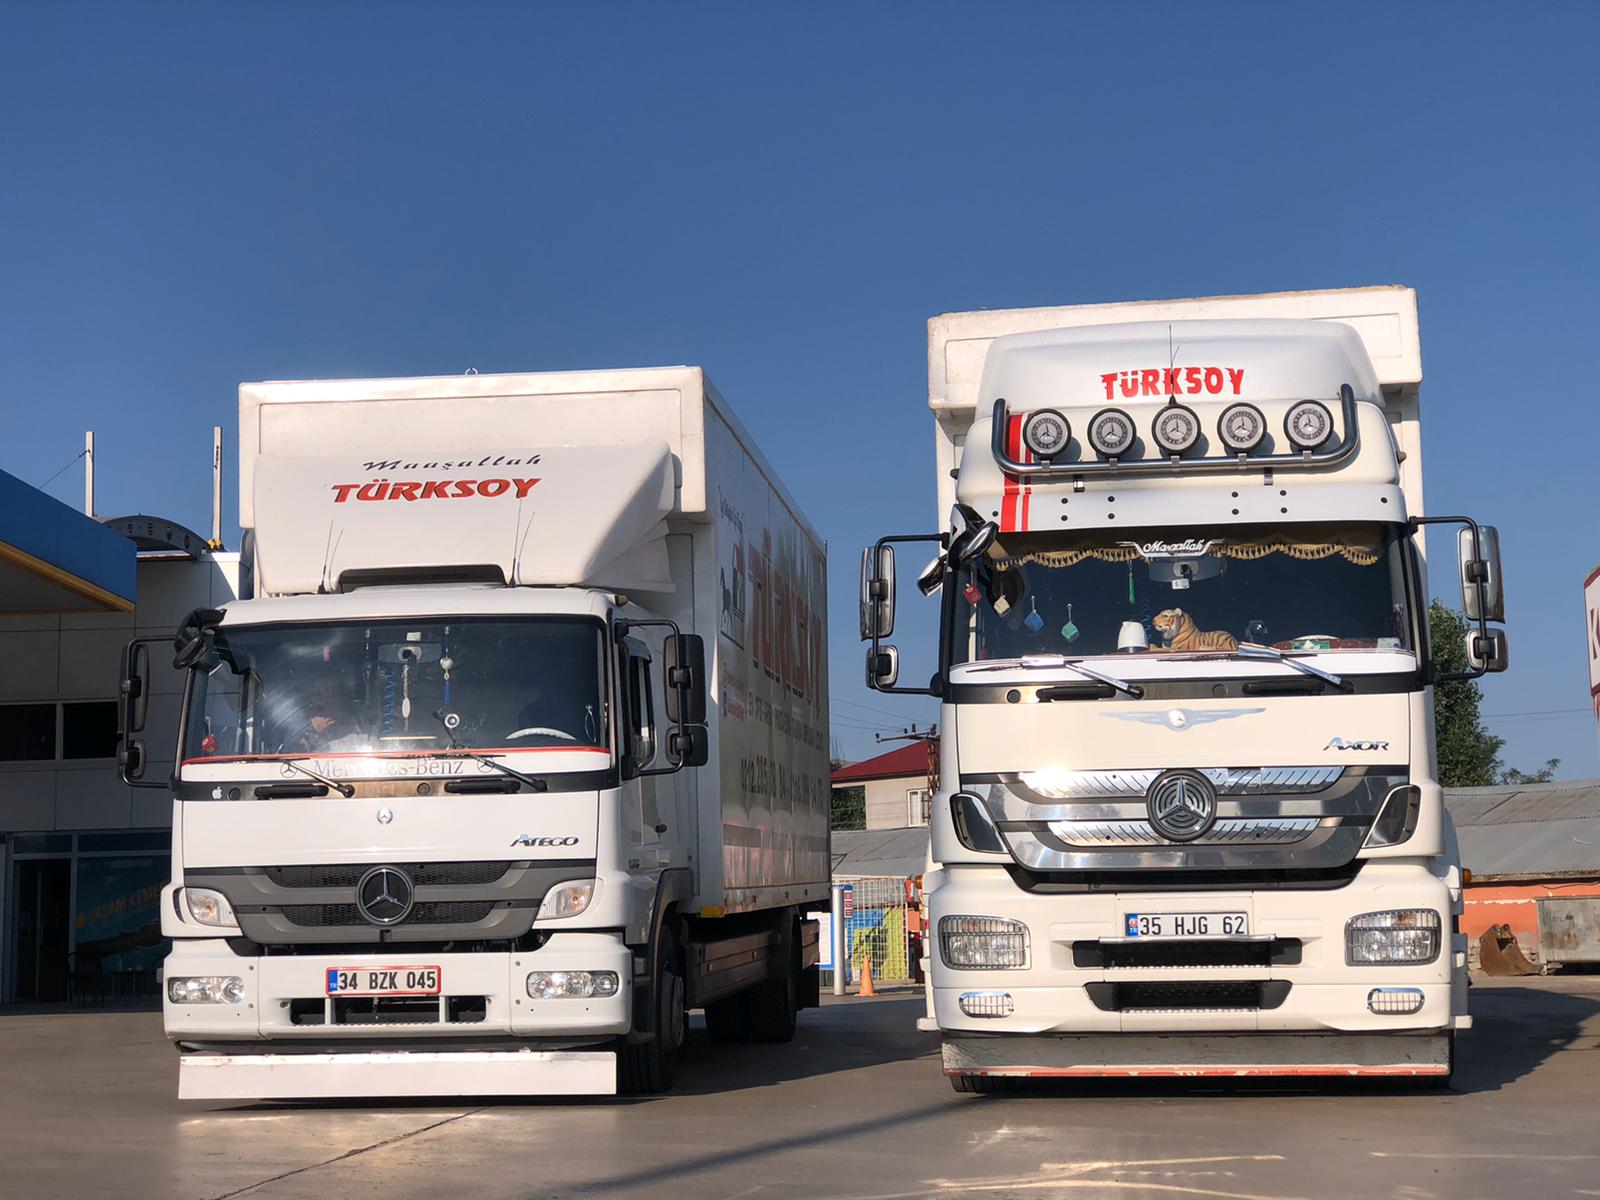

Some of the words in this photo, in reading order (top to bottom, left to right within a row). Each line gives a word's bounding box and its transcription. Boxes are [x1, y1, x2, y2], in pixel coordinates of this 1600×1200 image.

[1100, 366, 1244, 400] TÜRKSOY
[331, 477, 543, 504] TÜRKSOY
[1139, 916, 1162, 936] 35
[1174, 916, 1208, 935] HJG
[1222, 915, 1245, 935] 62
[338, 972, 358, 990] 34
[369, 971, 398, 990] BZK
[406, 971, 436, 989] 045
